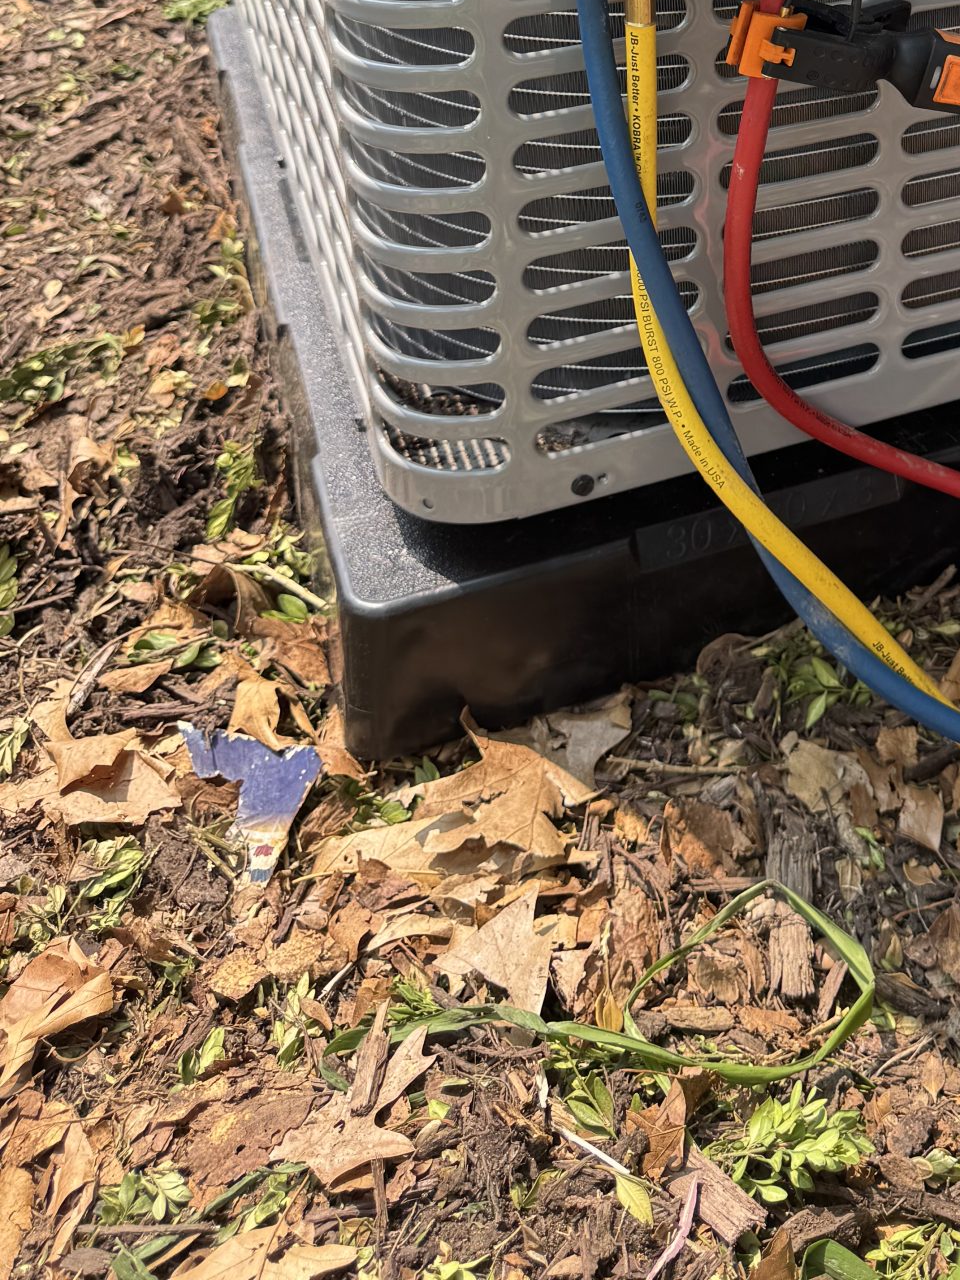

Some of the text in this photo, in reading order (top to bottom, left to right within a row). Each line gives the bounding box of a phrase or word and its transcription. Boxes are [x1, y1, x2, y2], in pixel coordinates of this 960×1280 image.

[630, 32, 639, 72] JB-Just
[632, 75, 640, 106] Better
[639, 294, 649, 312] PSI
[642, 314, 658, 353] BURST
[652, 355, 665, 376] 800
[659, 378, 672, 398] PSI
[667, 398, 683, 423] W.P.
[683, 429, 702, 457] Made
[699, 456, 709, 468] in
[707, 466, 726, 489] USA
[872, 641, 899, 670] JB-Just
